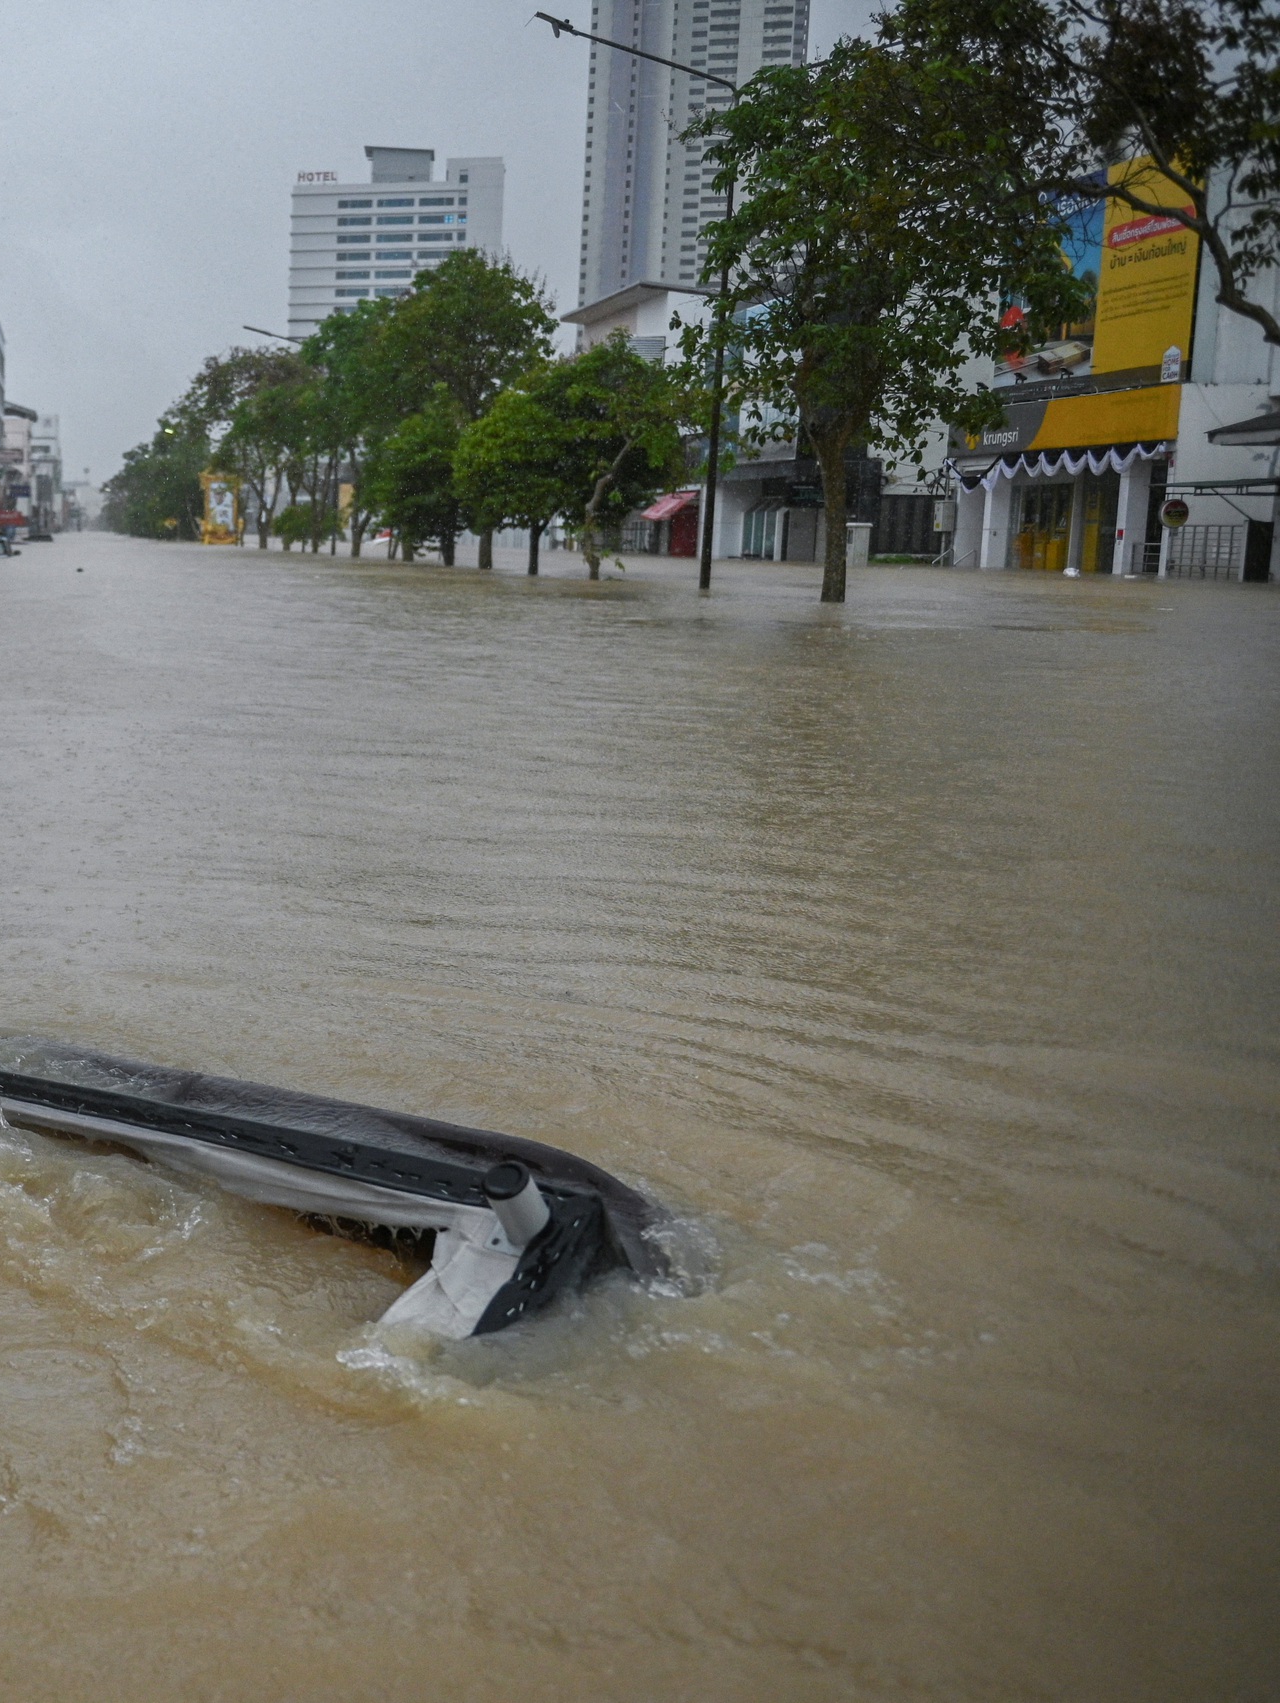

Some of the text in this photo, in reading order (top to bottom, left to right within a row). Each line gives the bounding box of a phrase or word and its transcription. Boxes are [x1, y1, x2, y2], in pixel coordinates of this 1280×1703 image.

[297, 171, 337, 182] HOTEL
[1110, 254, 1126, 269] บ้าน
[1134, 236, 1187, 264] เงินก้อนใหญ่
[1163, 357, 1179, 366] HOME
[982, 427, 1019, 448] krungsri
